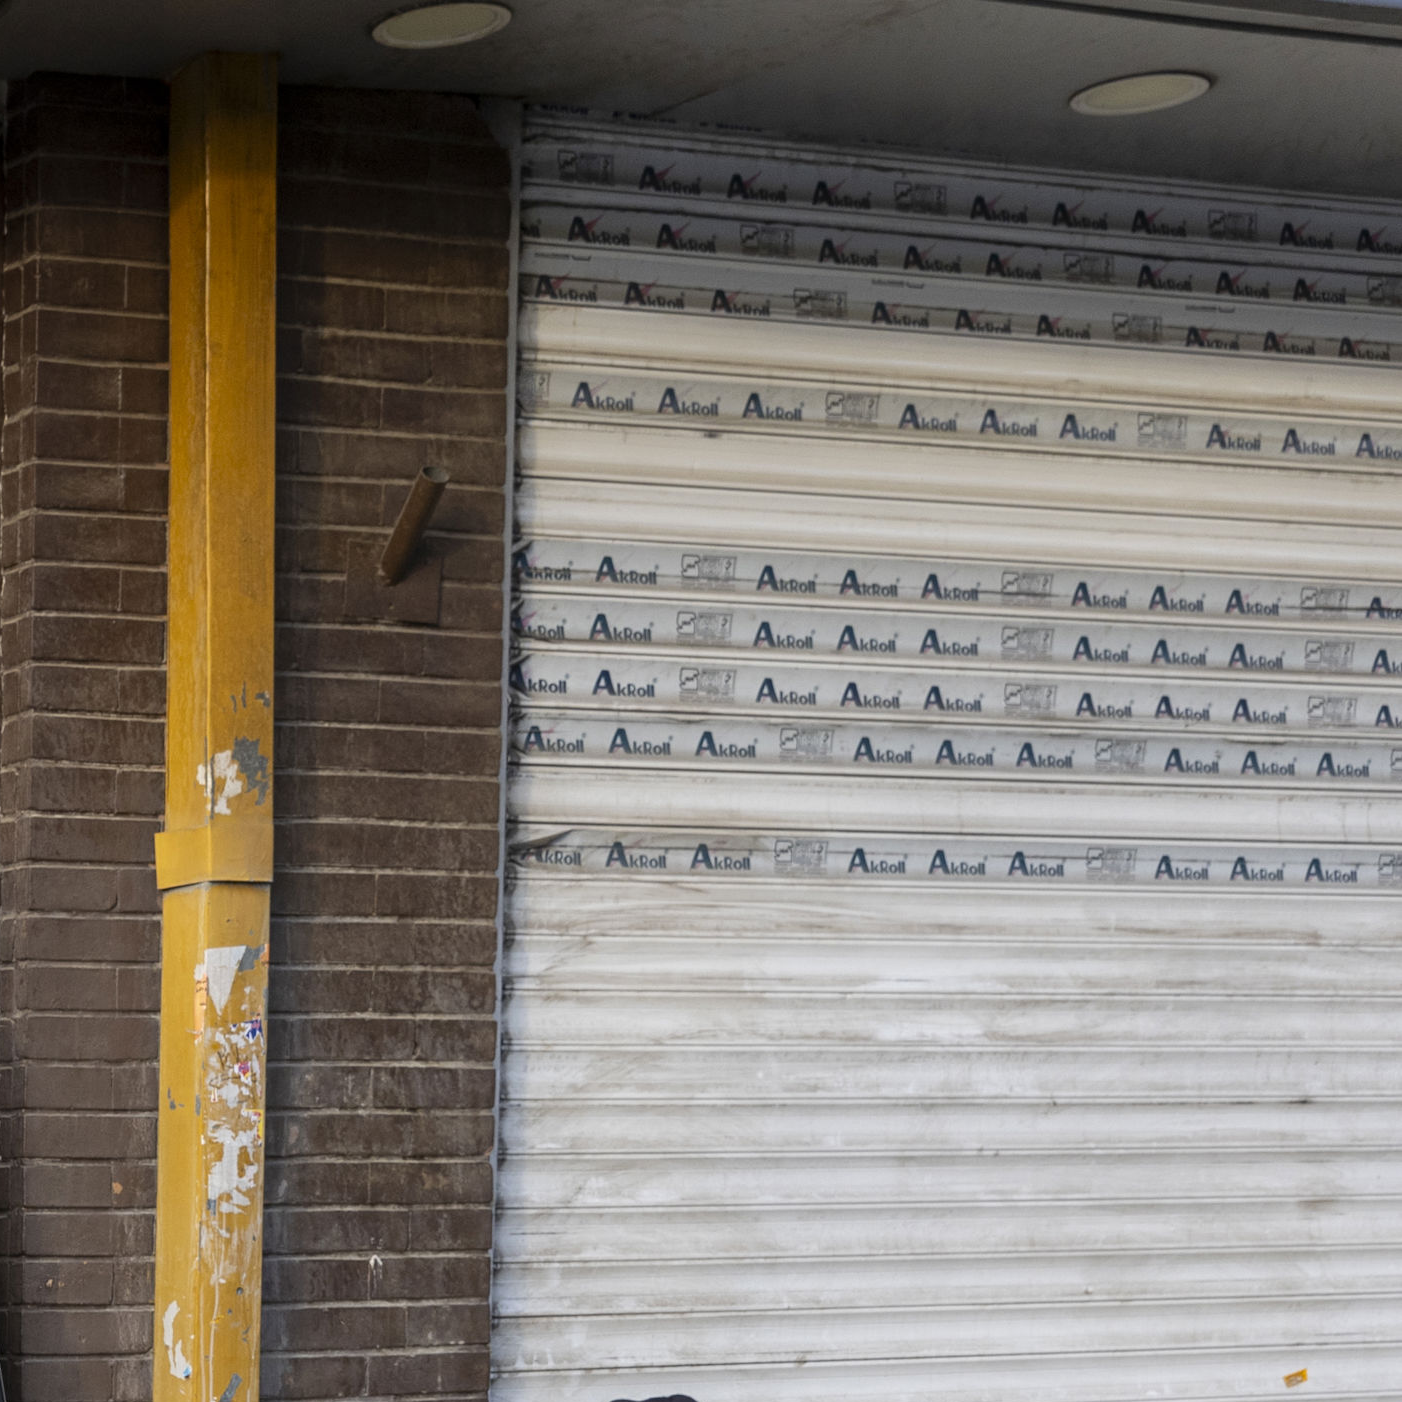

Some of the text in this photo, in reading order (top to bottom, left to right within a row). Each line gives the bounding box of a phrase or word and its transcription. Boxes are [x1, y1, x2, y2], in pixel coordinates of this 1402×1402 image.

[571, 382, 634, 412] AkRoll
[658, 388, 719, 416] AkRoll
[742, 393, 802, 421] AkRoll
[898, 404, 957, 432] AkRoll
[979, 409, 1037, 437] AkRoll
[1059, 414, 1116, 441] AkRoll
[1206, 424, 1261, 451] AkRoll
[1282, 429, 1335, 456] AkRoll
[1356, 433, 1402, 459] AkRo
[596, 556, 657, 585] AkRoll
[757, 565, 816, 594] AkRoll
[839, 570, 897, 598] AkRoll
[922, 574, 979, 601] AkRoll
[1071, 582, 1127, 609] AkRoll
[1148, 586, 1203, 612] AkRoll
[1226, 590, 1279, 616] AkRoll
[589, 614, 651, 642] AkRoll
[754, 622, 813, 649] AkRoll
[837, 626, 896, 653] AkRoll
[920, 630, 978, 656] AkRoll
[1072, 636, 1128, 663] AkRoll
[1151, 639, 1206, 666] AkRoll
[1229, 643, 1283, 670] AkRoll
[592, 670, 655, 698] AkRoll
[755, 678, 816, 705] AkRoll
[840, 682, 900, 710] AkRoll
[924, 686, 982, 713] AkRoll
[1076, 693, 1132, 719] AkRoll
[1154, 696, 1210, 722] AkRoll
[1232, 699, 1286, 725] AkRoll
[523, 726, 584, 753] AkRoll
[608, 728, 670, 756] AkRoll
[696, 731, 755, 759] AkRoll
[854, 737, 912, 764] AkRoll
[935, 740, 993, 766] AkRoll
[1016, 742, 1072, 768] AkRoll
[1164, 748, 1219, 774] AkRoll
[1241, 751, 1294, 776] AkRoll
[1317, 752, 1369, 777] AkRoll
[605, 841, 666, 869] AkRoll
[690, 844, 750, 870] AkRoll
[848, 848, 906, 875] AkRoll
[928, 850, 985, 876] AkRoll
[1008, 851, 1064, 878] AkRoll
[1155, 855, 1209, 881] AkRoll
[1230, 856, 1283, 882] AkRoll
[1305, 858, 1357, 883] AkRoll
